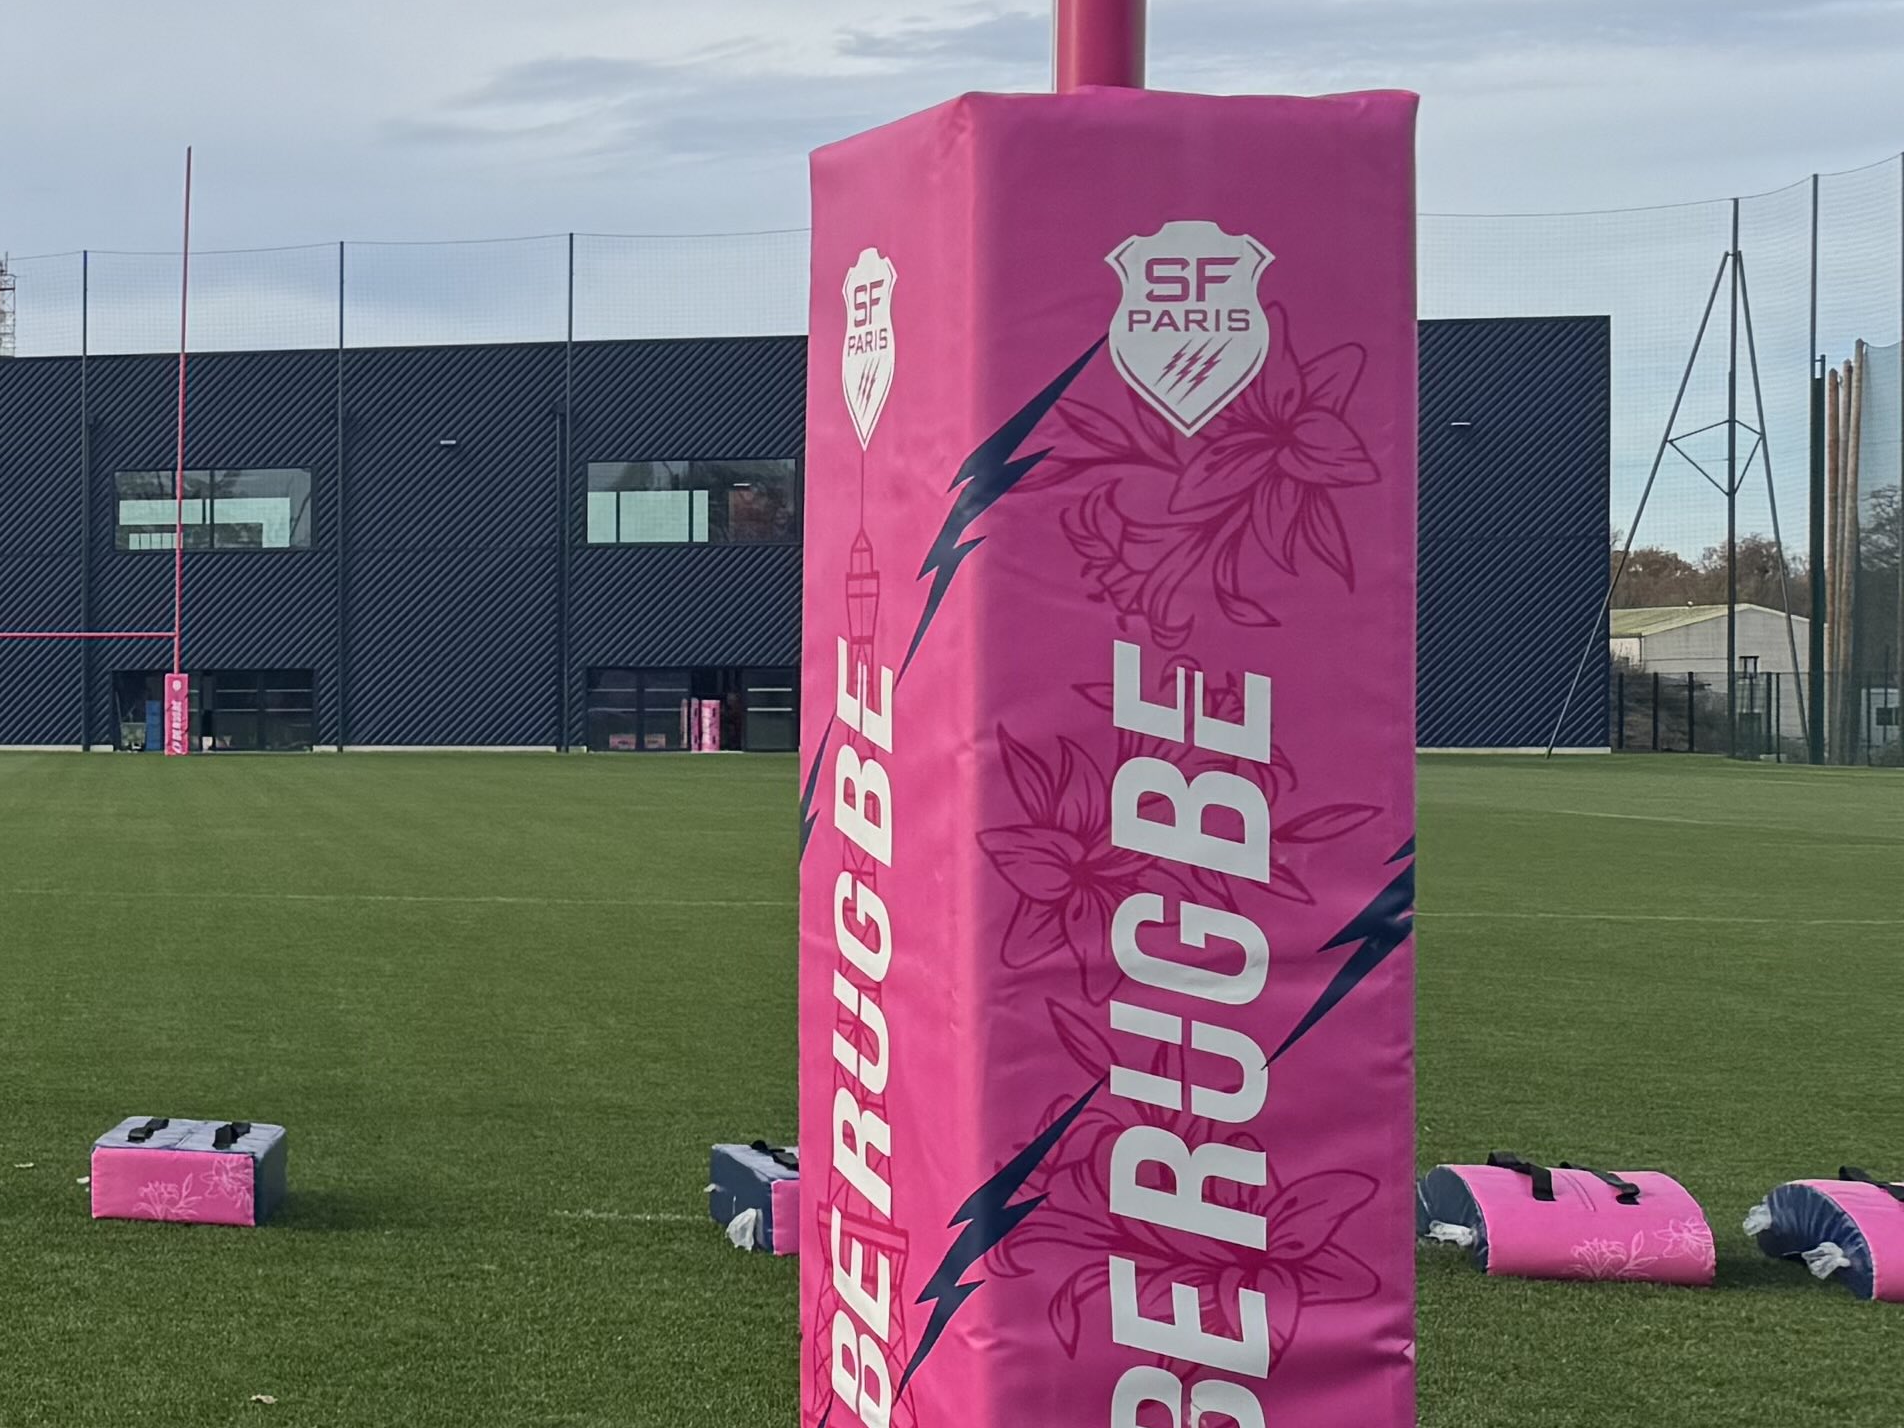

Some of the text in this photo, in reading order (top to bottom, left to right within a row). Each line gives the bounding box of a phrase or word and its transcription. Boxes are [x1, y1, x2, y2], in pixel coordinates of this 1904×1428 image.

[853, 279, 885, 328] SF
[1145, 256, 1241, 303] SF
[846, 327, 888, 357] PARIS
[1127, 308, 1251, 333] PARIS
[831, 635, 894, 1220] RUGBE
[1108, 638, 1271, 1252] RUGBE
